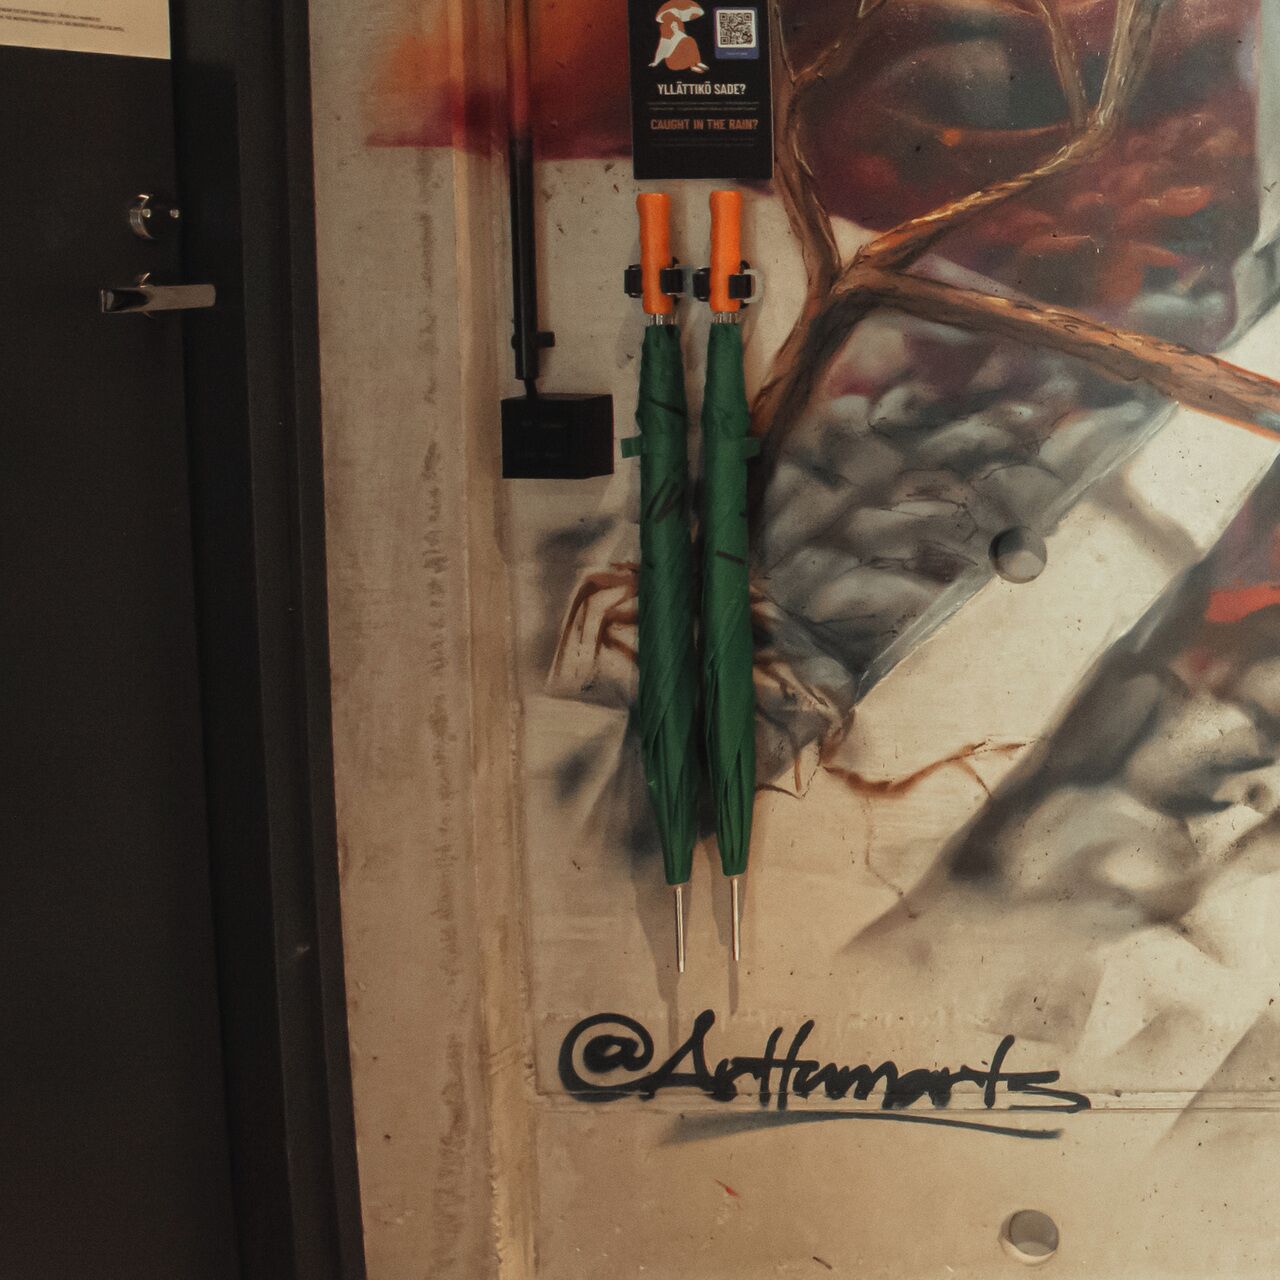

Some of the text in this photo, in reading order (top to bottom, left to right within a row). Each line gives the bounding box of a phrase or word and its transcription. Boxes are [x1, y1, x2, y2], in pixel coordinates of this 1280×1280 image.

[657, 81, 747, 95] YLLÄTTIKÖ SADE?
[650, 118, 759, 130] CAUGHT IN THE RAIN?
